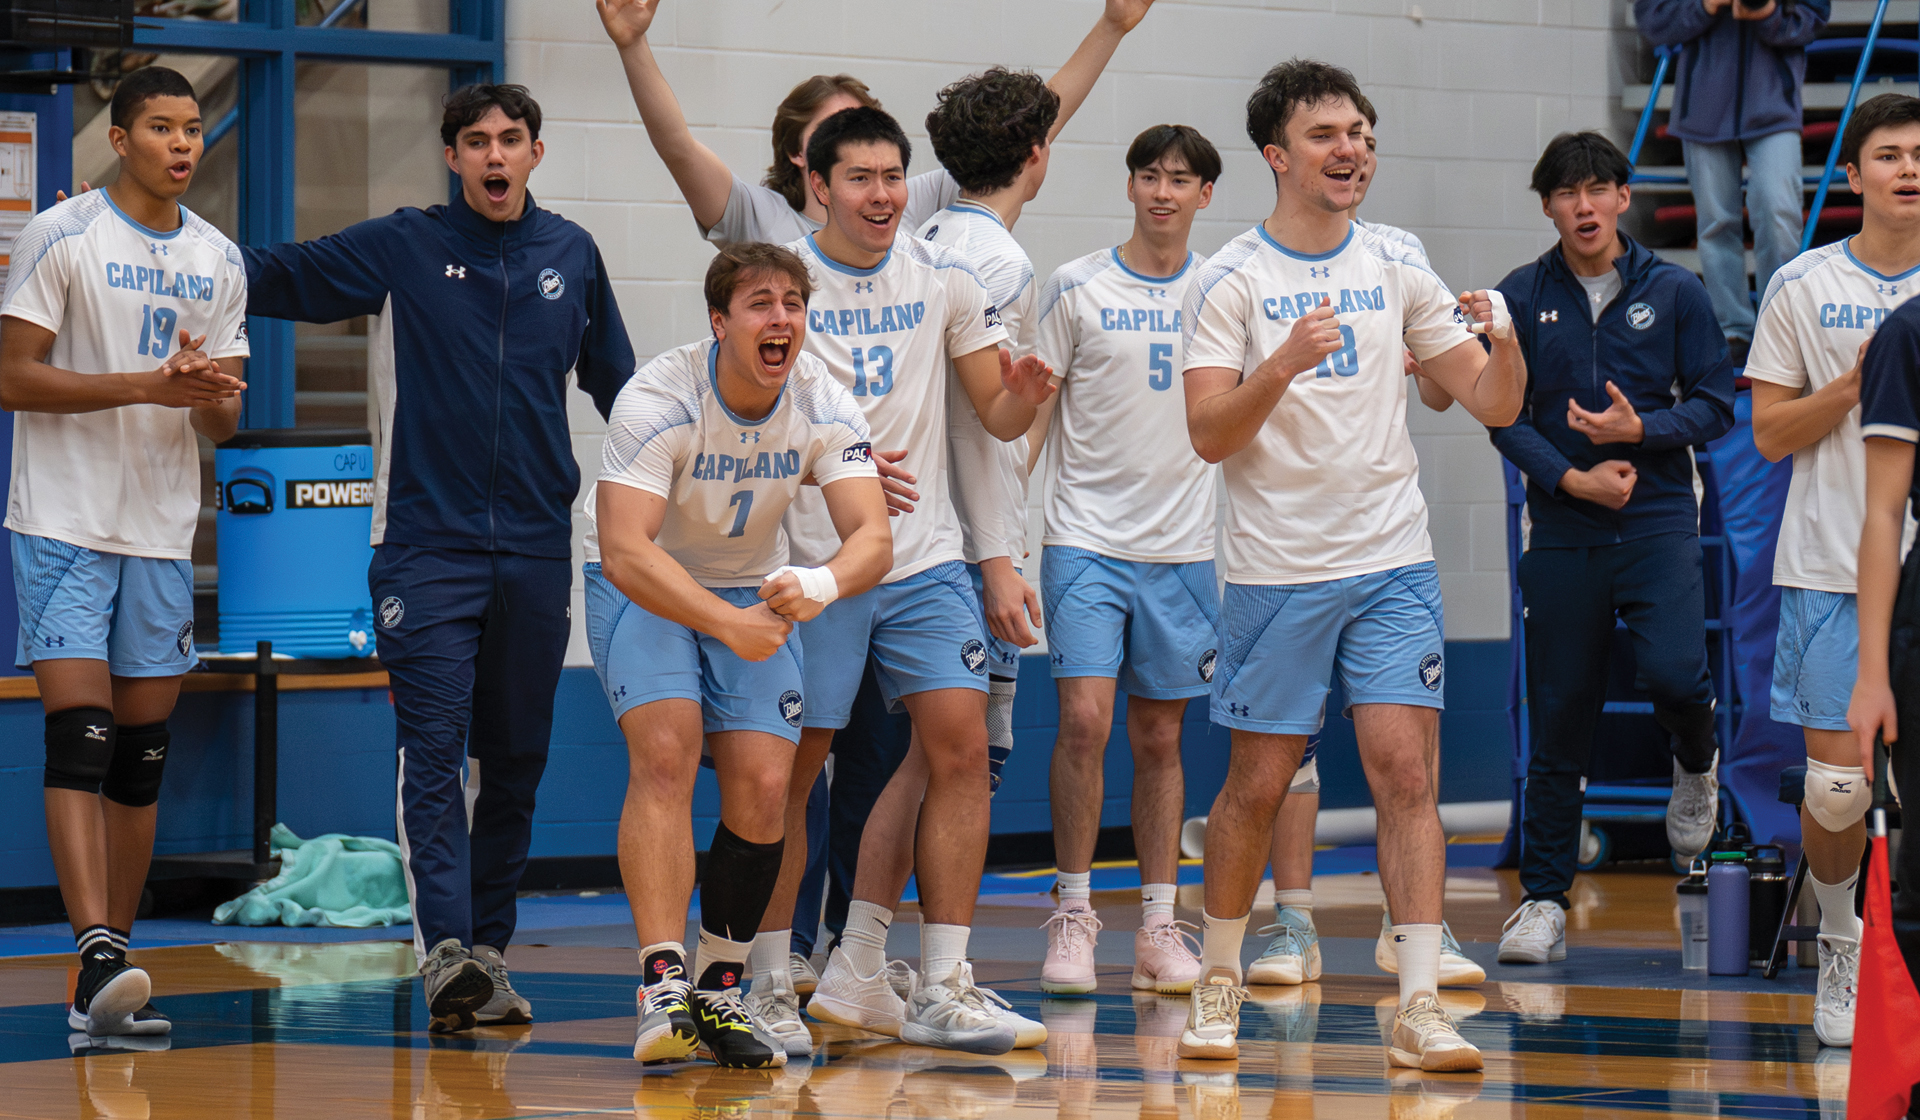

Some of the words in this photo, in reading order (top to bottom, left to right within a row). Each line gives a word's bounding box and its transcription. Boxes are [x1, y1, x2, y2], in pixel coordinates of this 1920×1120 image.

[106, 262, 214, 301] CAPILANO
[138, 304, 177, 359] 19
[809, 301, 925, 335] CAPILANO
[851, 345, 894, 397] 13
[1148, 343, 1173, 392] 5
[692, 449, 800, 484] CAPILANO
[728, 490, 753, 538] 7
